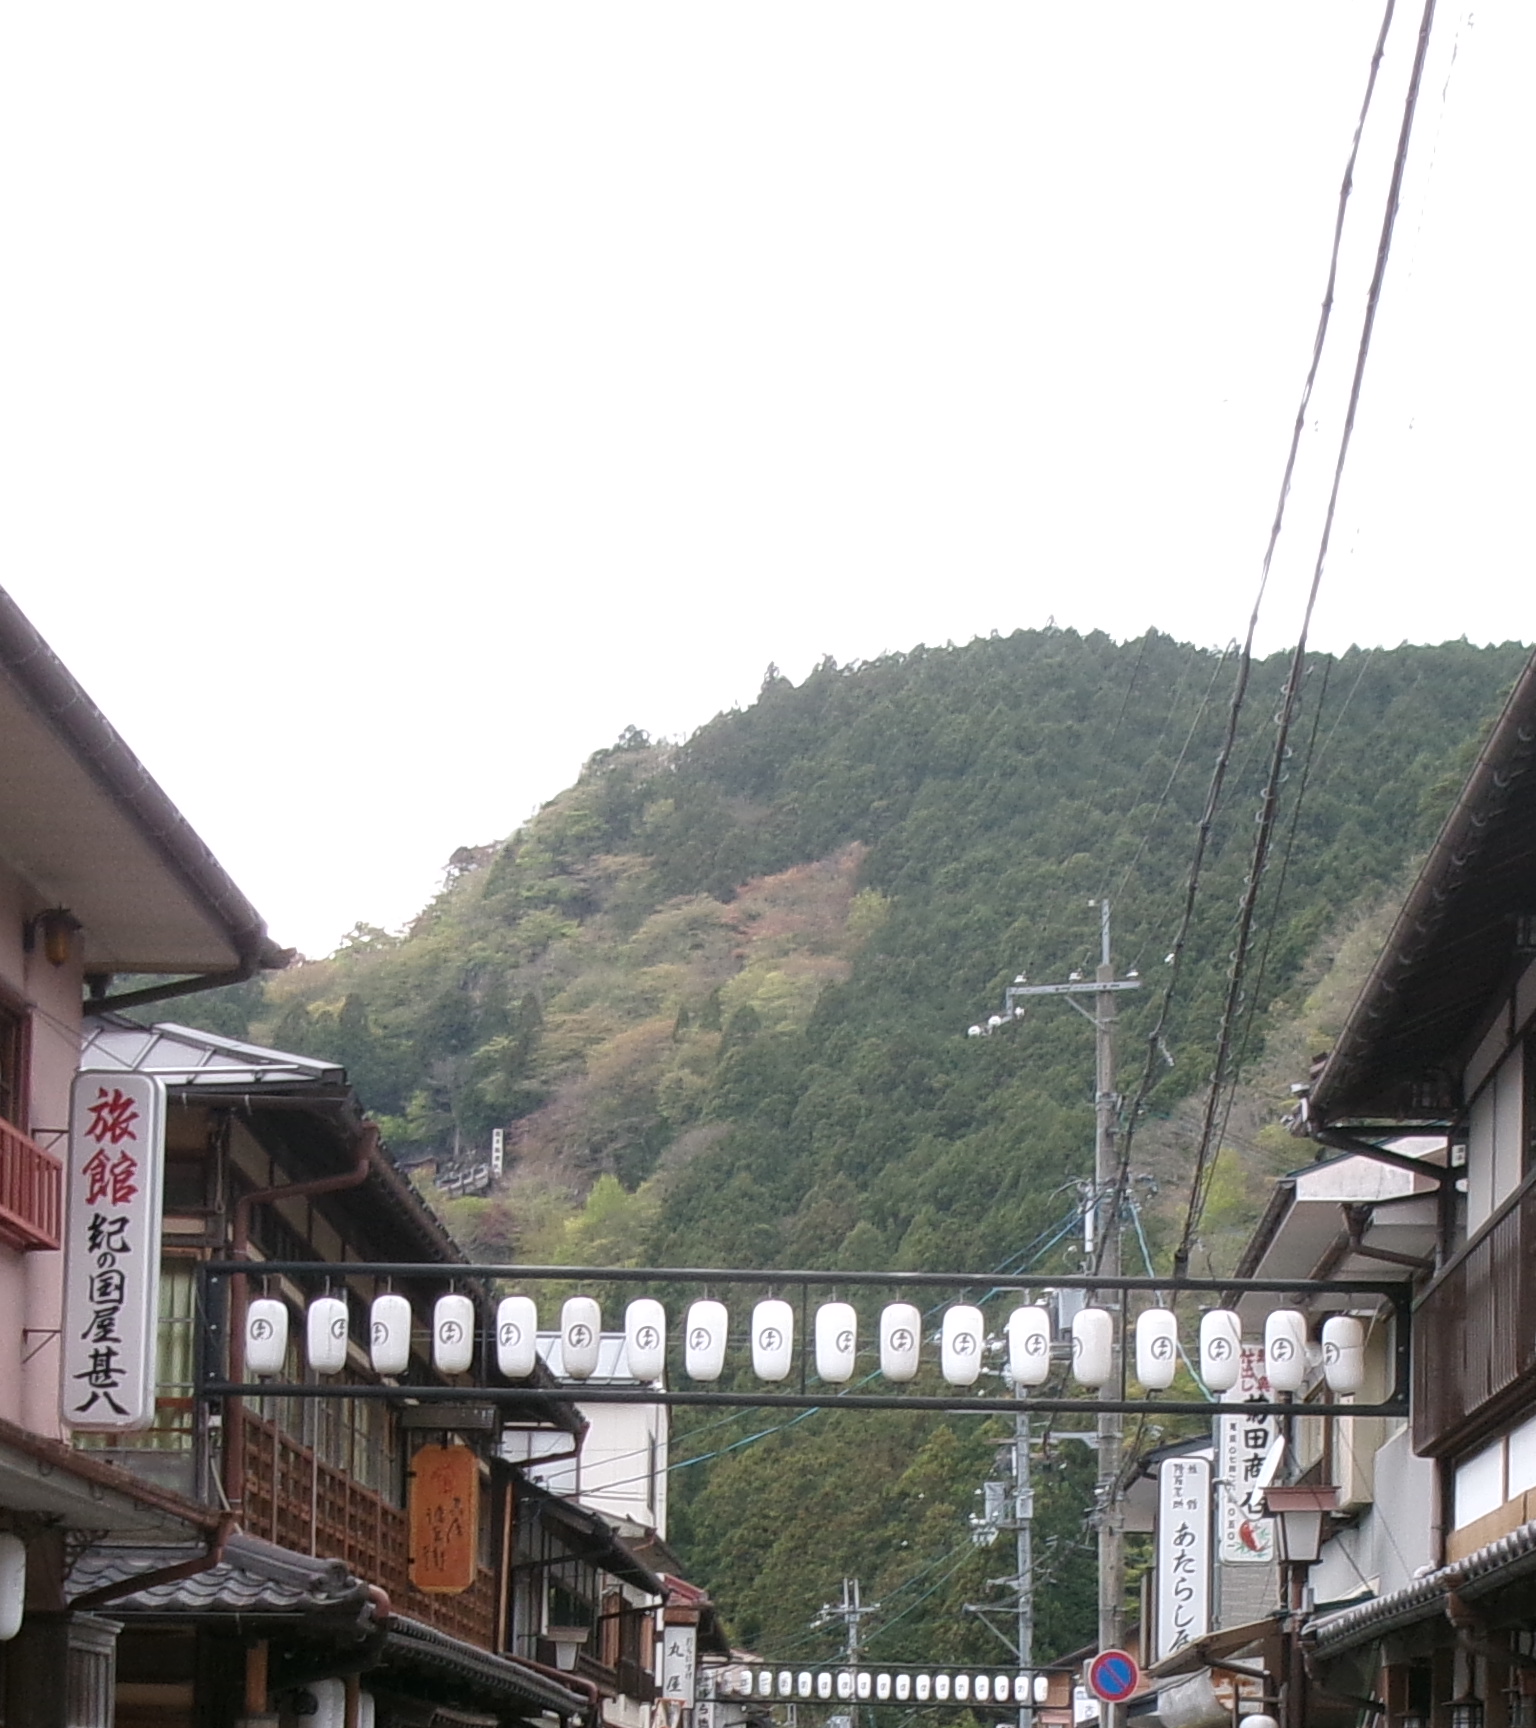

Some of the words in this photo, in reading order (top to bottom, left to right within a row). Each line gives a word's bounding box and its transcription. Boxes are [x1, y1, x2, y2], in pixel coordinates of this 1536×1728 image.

[81, 1086, 141, 1206] 旅館
[73, 1212, 132, 1416] 紀の国屋甚八
[666, 1641, 685, 1692] 丸屋
